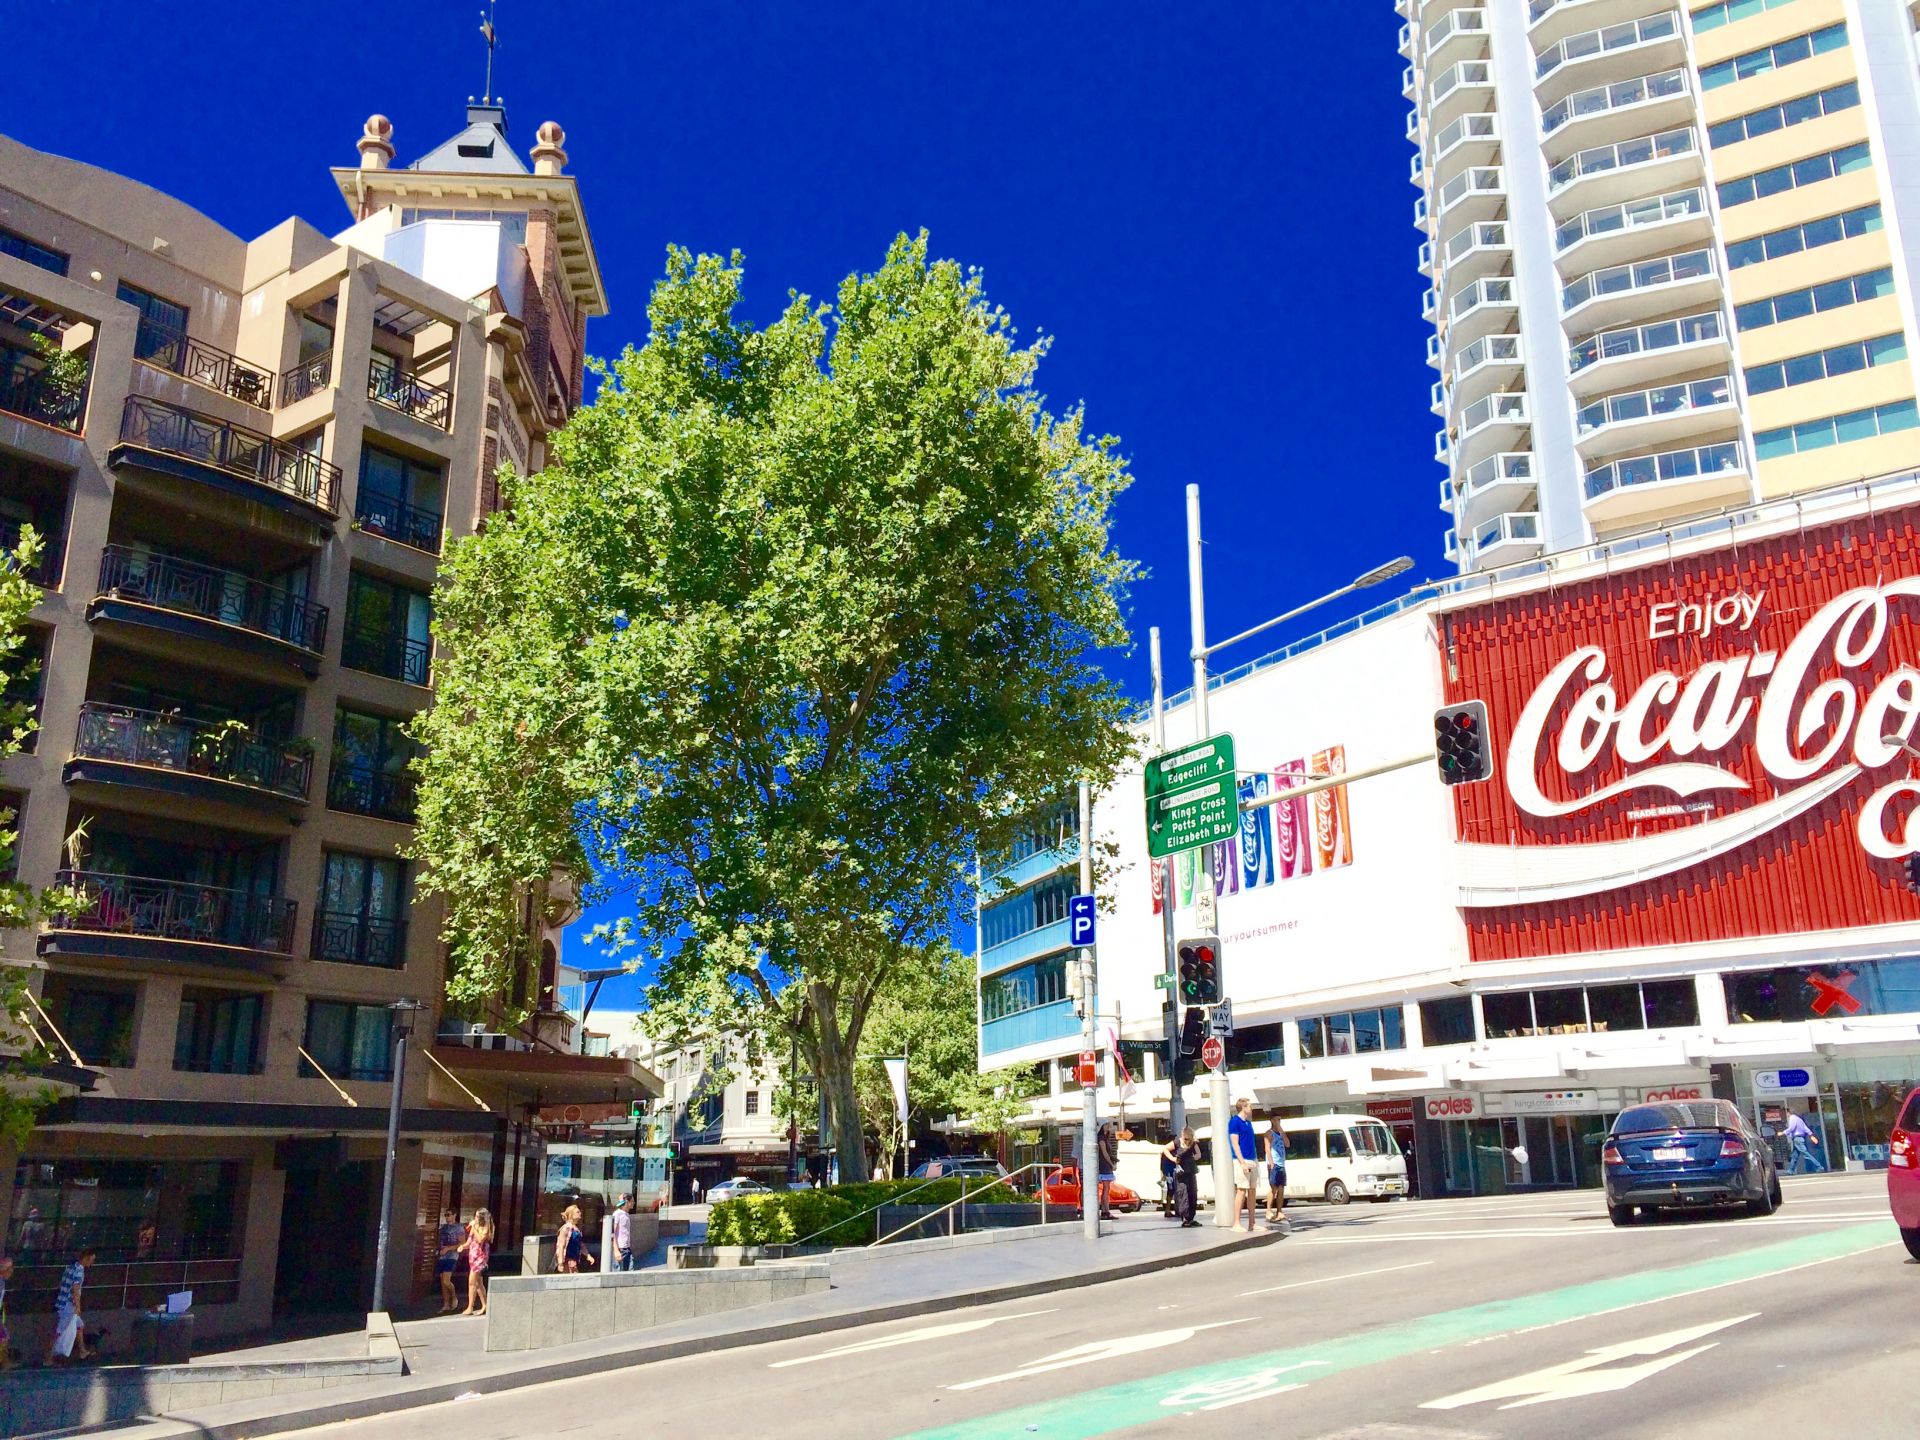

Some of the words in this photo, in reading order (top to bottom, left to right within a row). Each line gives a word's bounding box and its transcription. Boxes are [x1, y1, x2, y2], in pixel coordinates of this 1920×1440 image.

[1648, 589, 1770, 641] Enjoy
[1506, 577, 1920, 817] Coca-Co
[1168, 763, 1207, 784] Edgecliff
[1204, 783, 1219, 796] ROAD
[1172, 806, 1196, 820] Kings
[1201, 797, 1226, 811] Cross
[1627, 809, 1657, 821] TRADE
[1659, 805, 1685, 816] MARK
[1172, 819, 1196, 833] Potts
[1200, 809, 1225, 825] Point
[1167, 826, 1210, 848] Elizabeth
[1214, 822, 1232, 834] Bay
[1075, 917, 1091, 941] P
[1198, 914, 1214, 924] LANE
[1221, 920, 1298, 944] uryoursummer
[1212, 1012, 1229, 1022] WAY
[1129, 1041, 1154, 1049] William
[1204, 1048, 1220, 1059] STOP
[1646, 1087, 1702, 1103] coles
[1368, 1107, 1389, 1116] FLIGHT
[1389, 1106, 1412, 1115] CENTRE
[1428, 1096, 1473, 1116] coles
